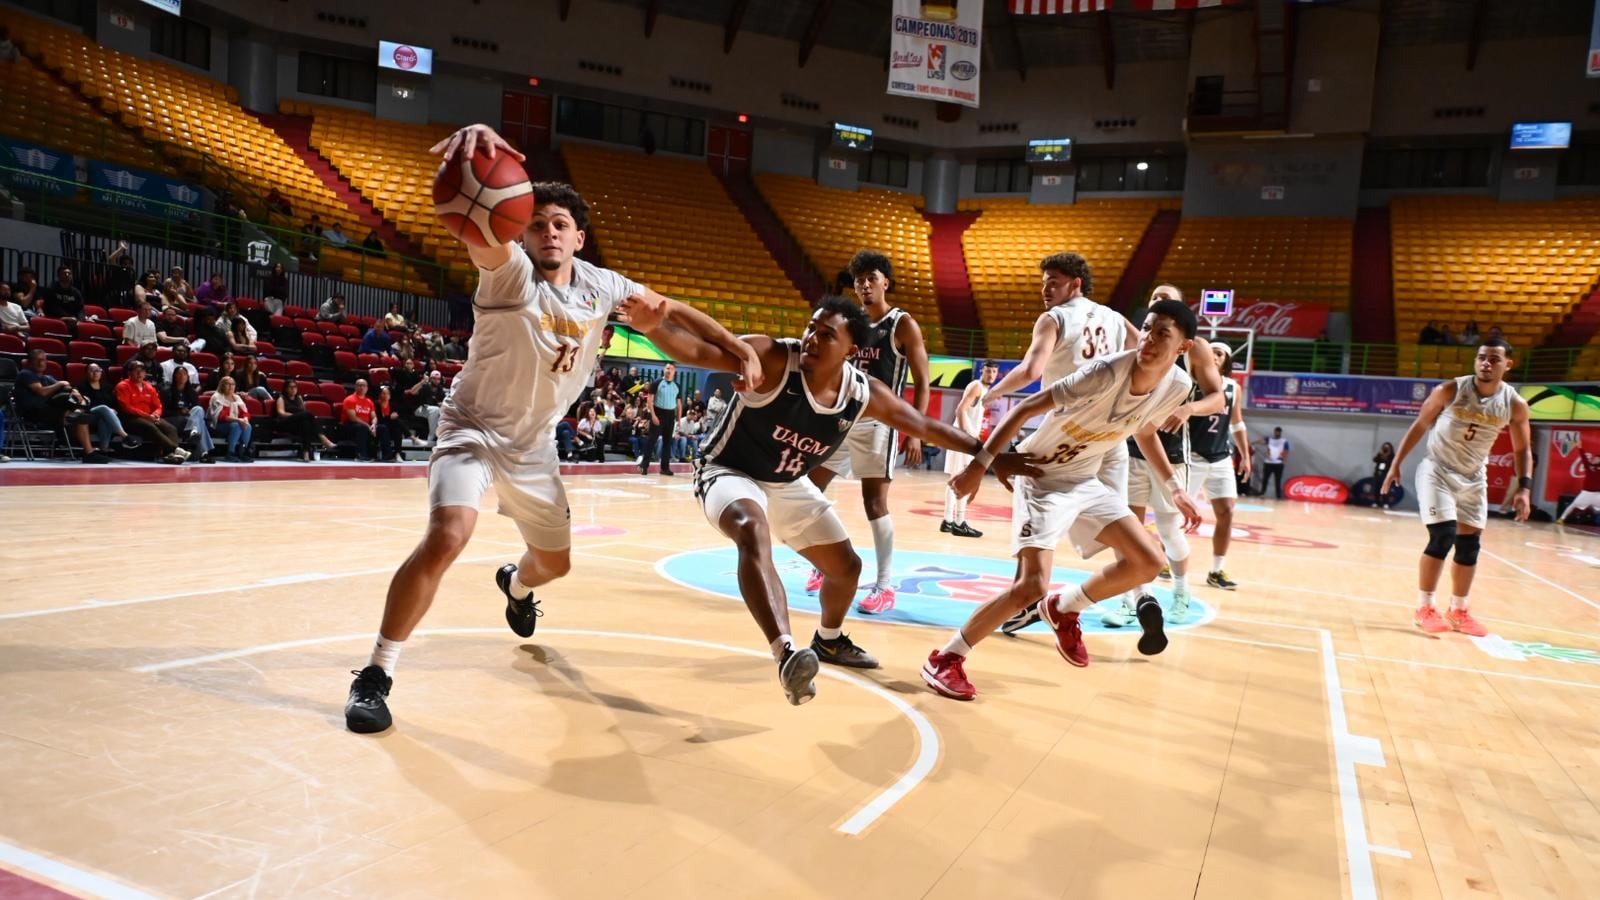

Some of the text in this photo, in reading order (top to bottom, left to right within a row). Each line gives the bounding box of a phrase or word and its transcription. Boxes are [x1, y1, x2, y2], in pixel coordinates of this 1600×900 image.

[895, 17, 978, 46] CAMPEONAS 2013
[1081, 326, 1110, 359] 33
[550, 343, 580, 373] 13
[855, 346, 881, 361] AGM
[1207, 415, 1220, 433] 2
[1464, 423, 1479, 441] 5
[772, 424, 833, 457] UAGM
[774, 447, 805, 477] 14
[1041, 443, 1088, 464] 35
[1289, 481, 1341, 498] Coca-Cola
[1022, 523, 1032, 537] S
